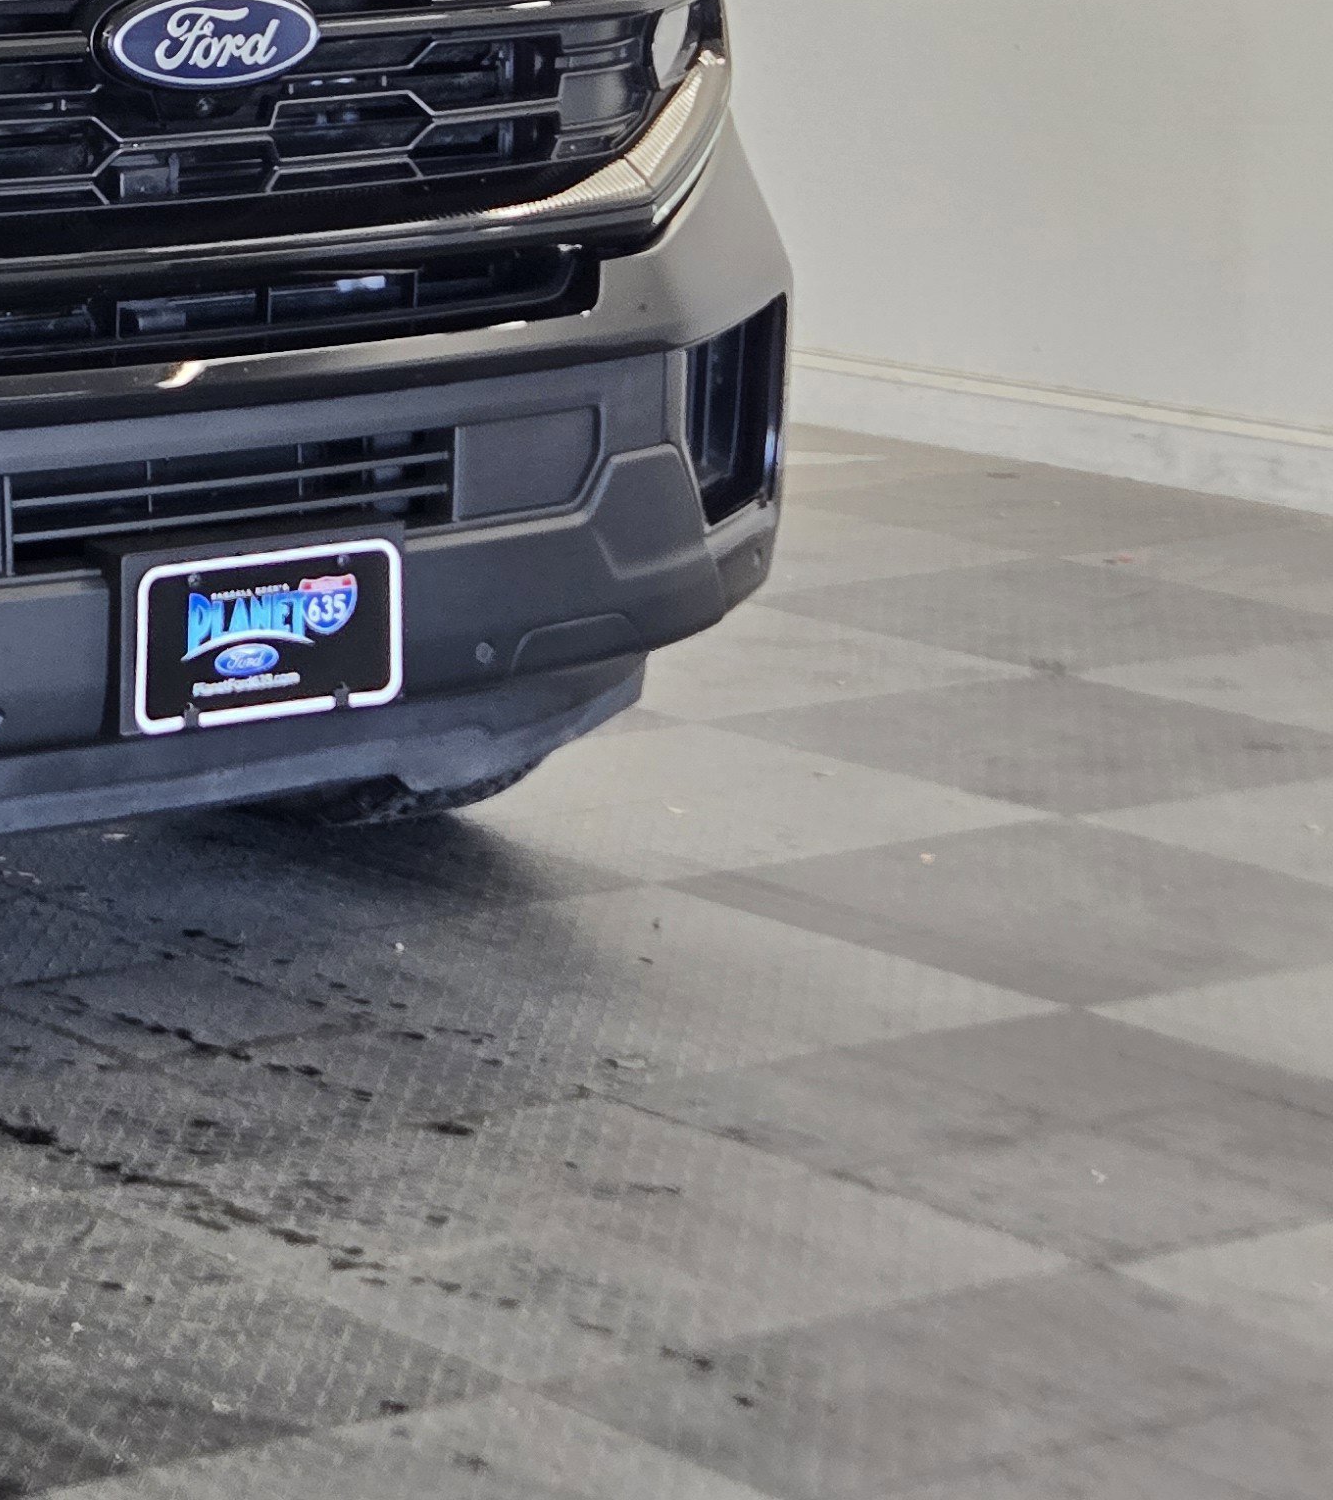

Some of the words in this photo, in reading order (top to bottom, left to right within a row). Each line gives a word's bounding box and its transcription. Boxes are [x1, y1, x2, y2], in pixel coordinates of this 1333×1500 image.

[154, 6, 281, 70] Ford
[187, 591, 307, 654] PLANET
[307, 593, 347, 623] 635
